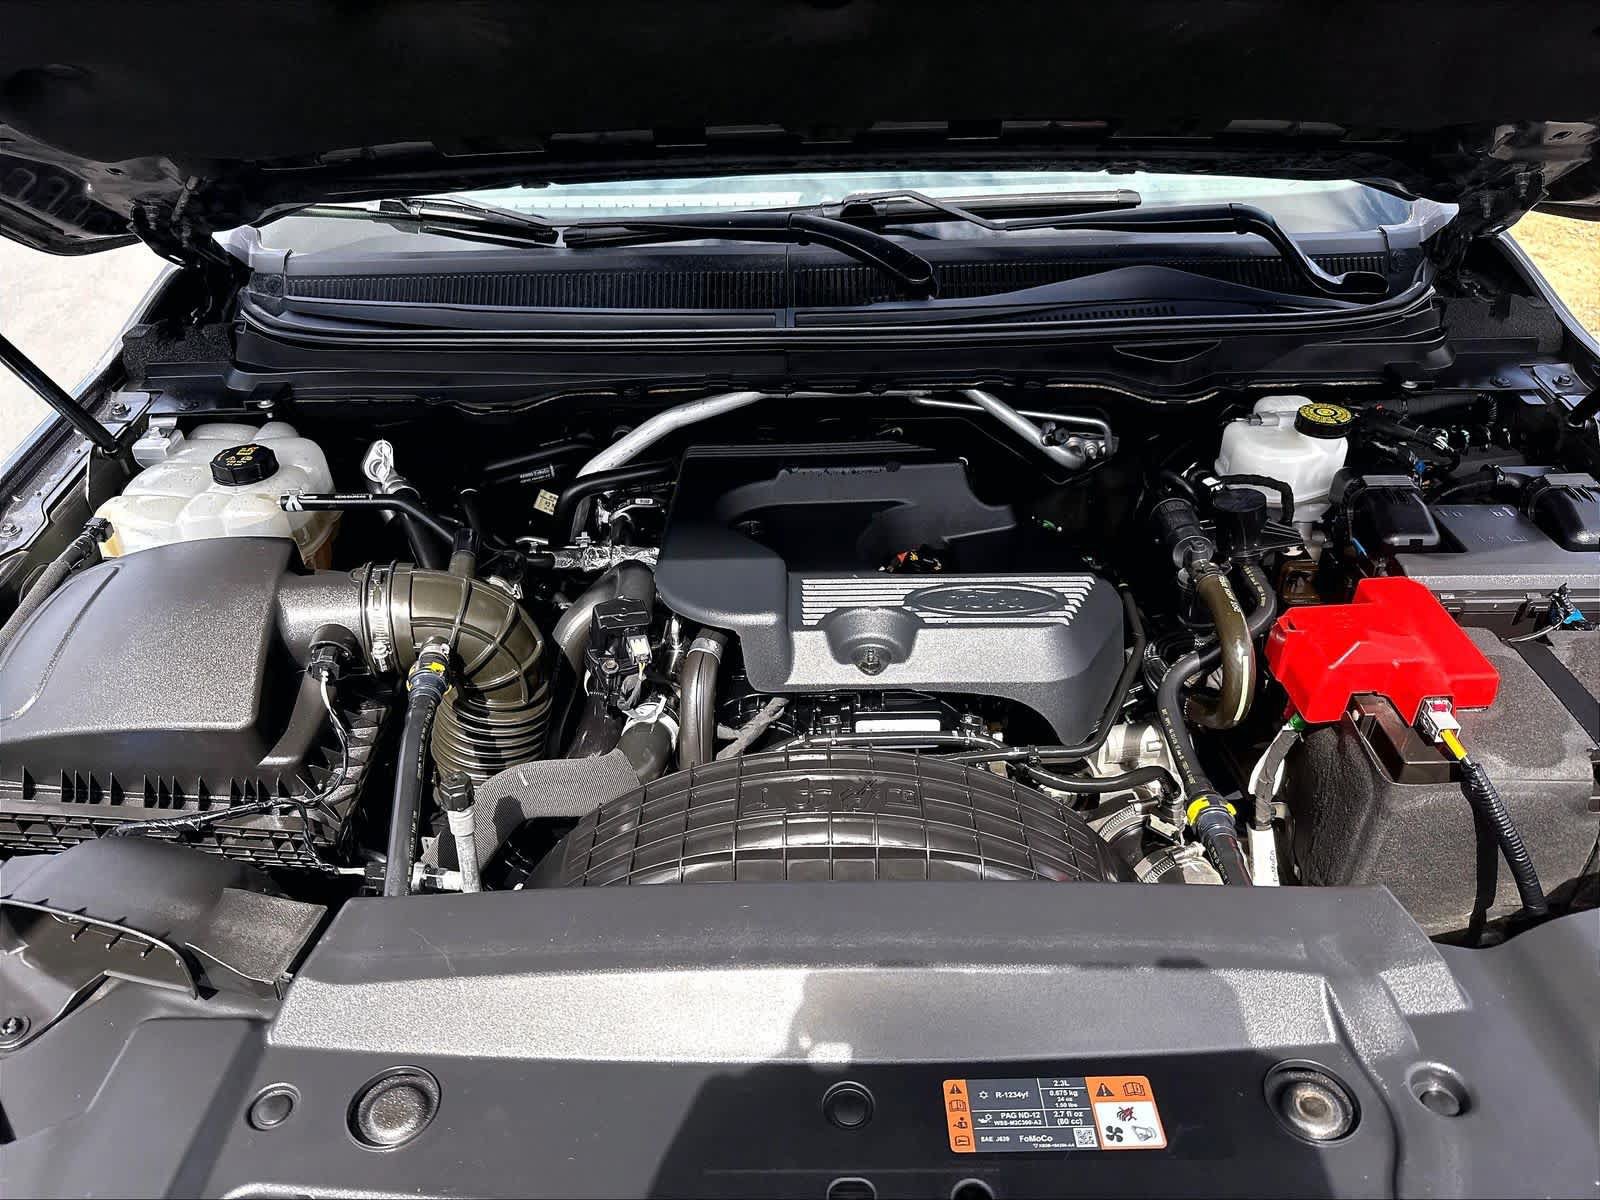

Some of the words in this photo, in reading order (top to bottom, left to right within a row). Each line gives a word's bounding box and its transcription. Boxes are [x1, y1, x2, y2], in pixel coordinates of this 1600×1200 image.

[995, 1090, 1029, 1099] R-1234yf
[1018, 1111, 1041, 1119] ND-12
[1019, 1134, 1053, 1142] FoMoCo
